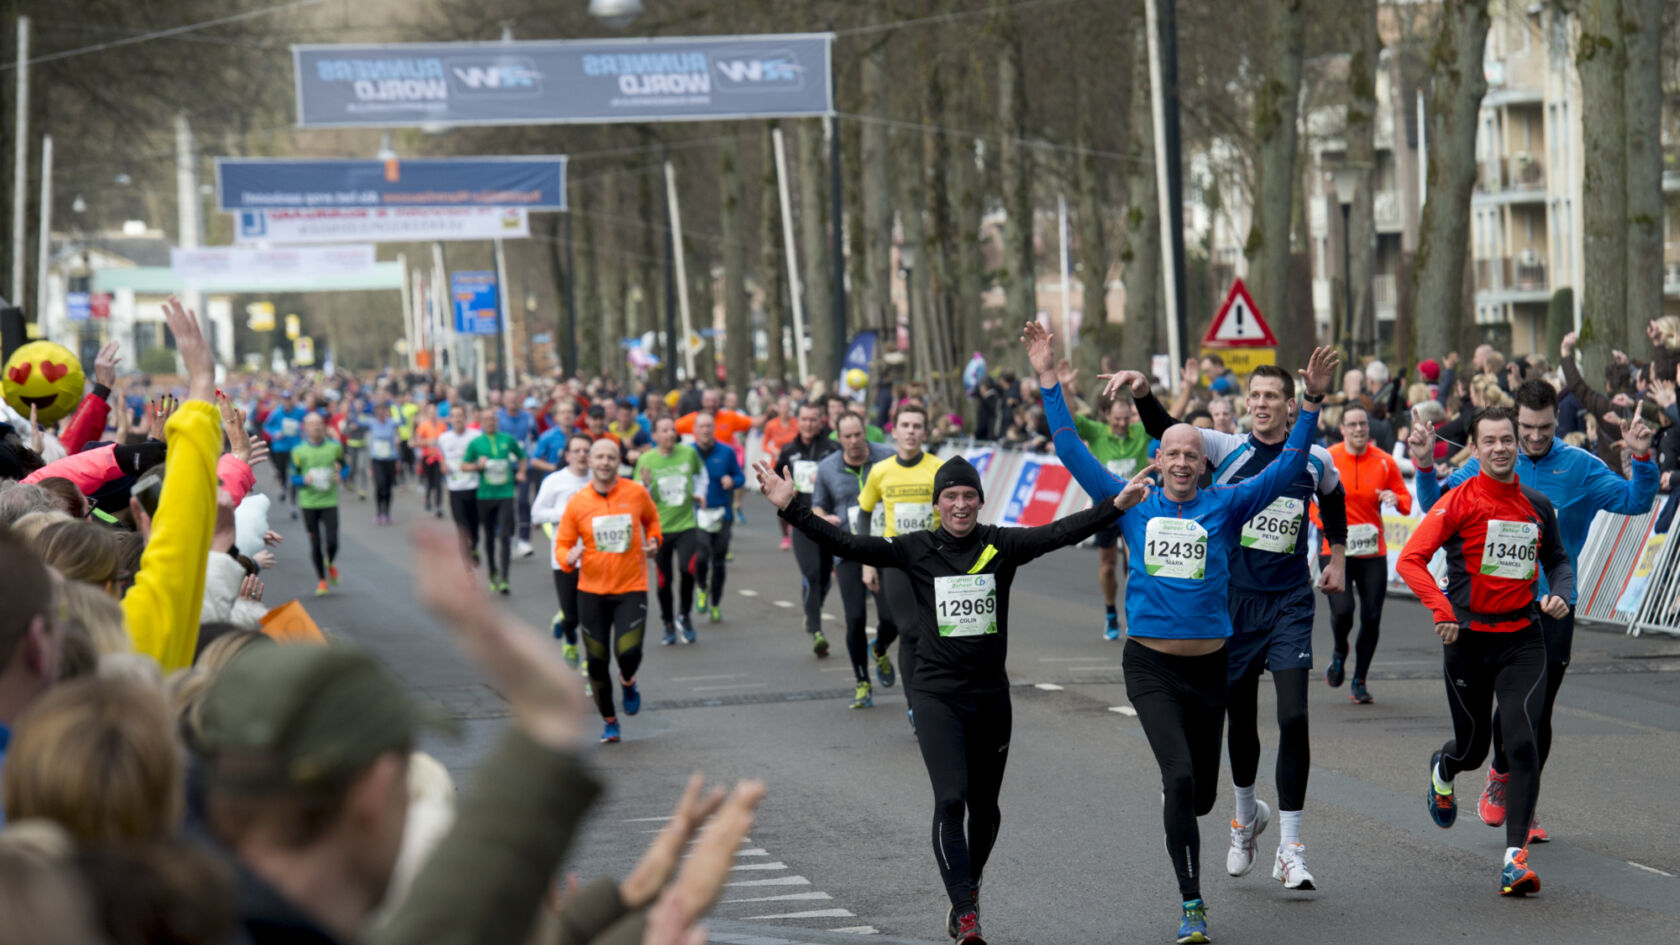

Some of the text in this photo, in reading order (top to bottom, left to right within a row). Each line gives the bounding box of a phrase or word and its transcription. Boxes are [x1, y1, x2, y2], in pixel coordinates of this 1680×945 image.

[897, 517, 932, 529] 10847
[1248, 515, 1300, 536] 12665
[595, 529, 631, 541] 11021
[1261, 533, 1280, 541] PETER
[1147, 539, 1205, 560] 12439
[1487, 542, 1535, 561] 13406
[938, 597, 995, 617] 12969
